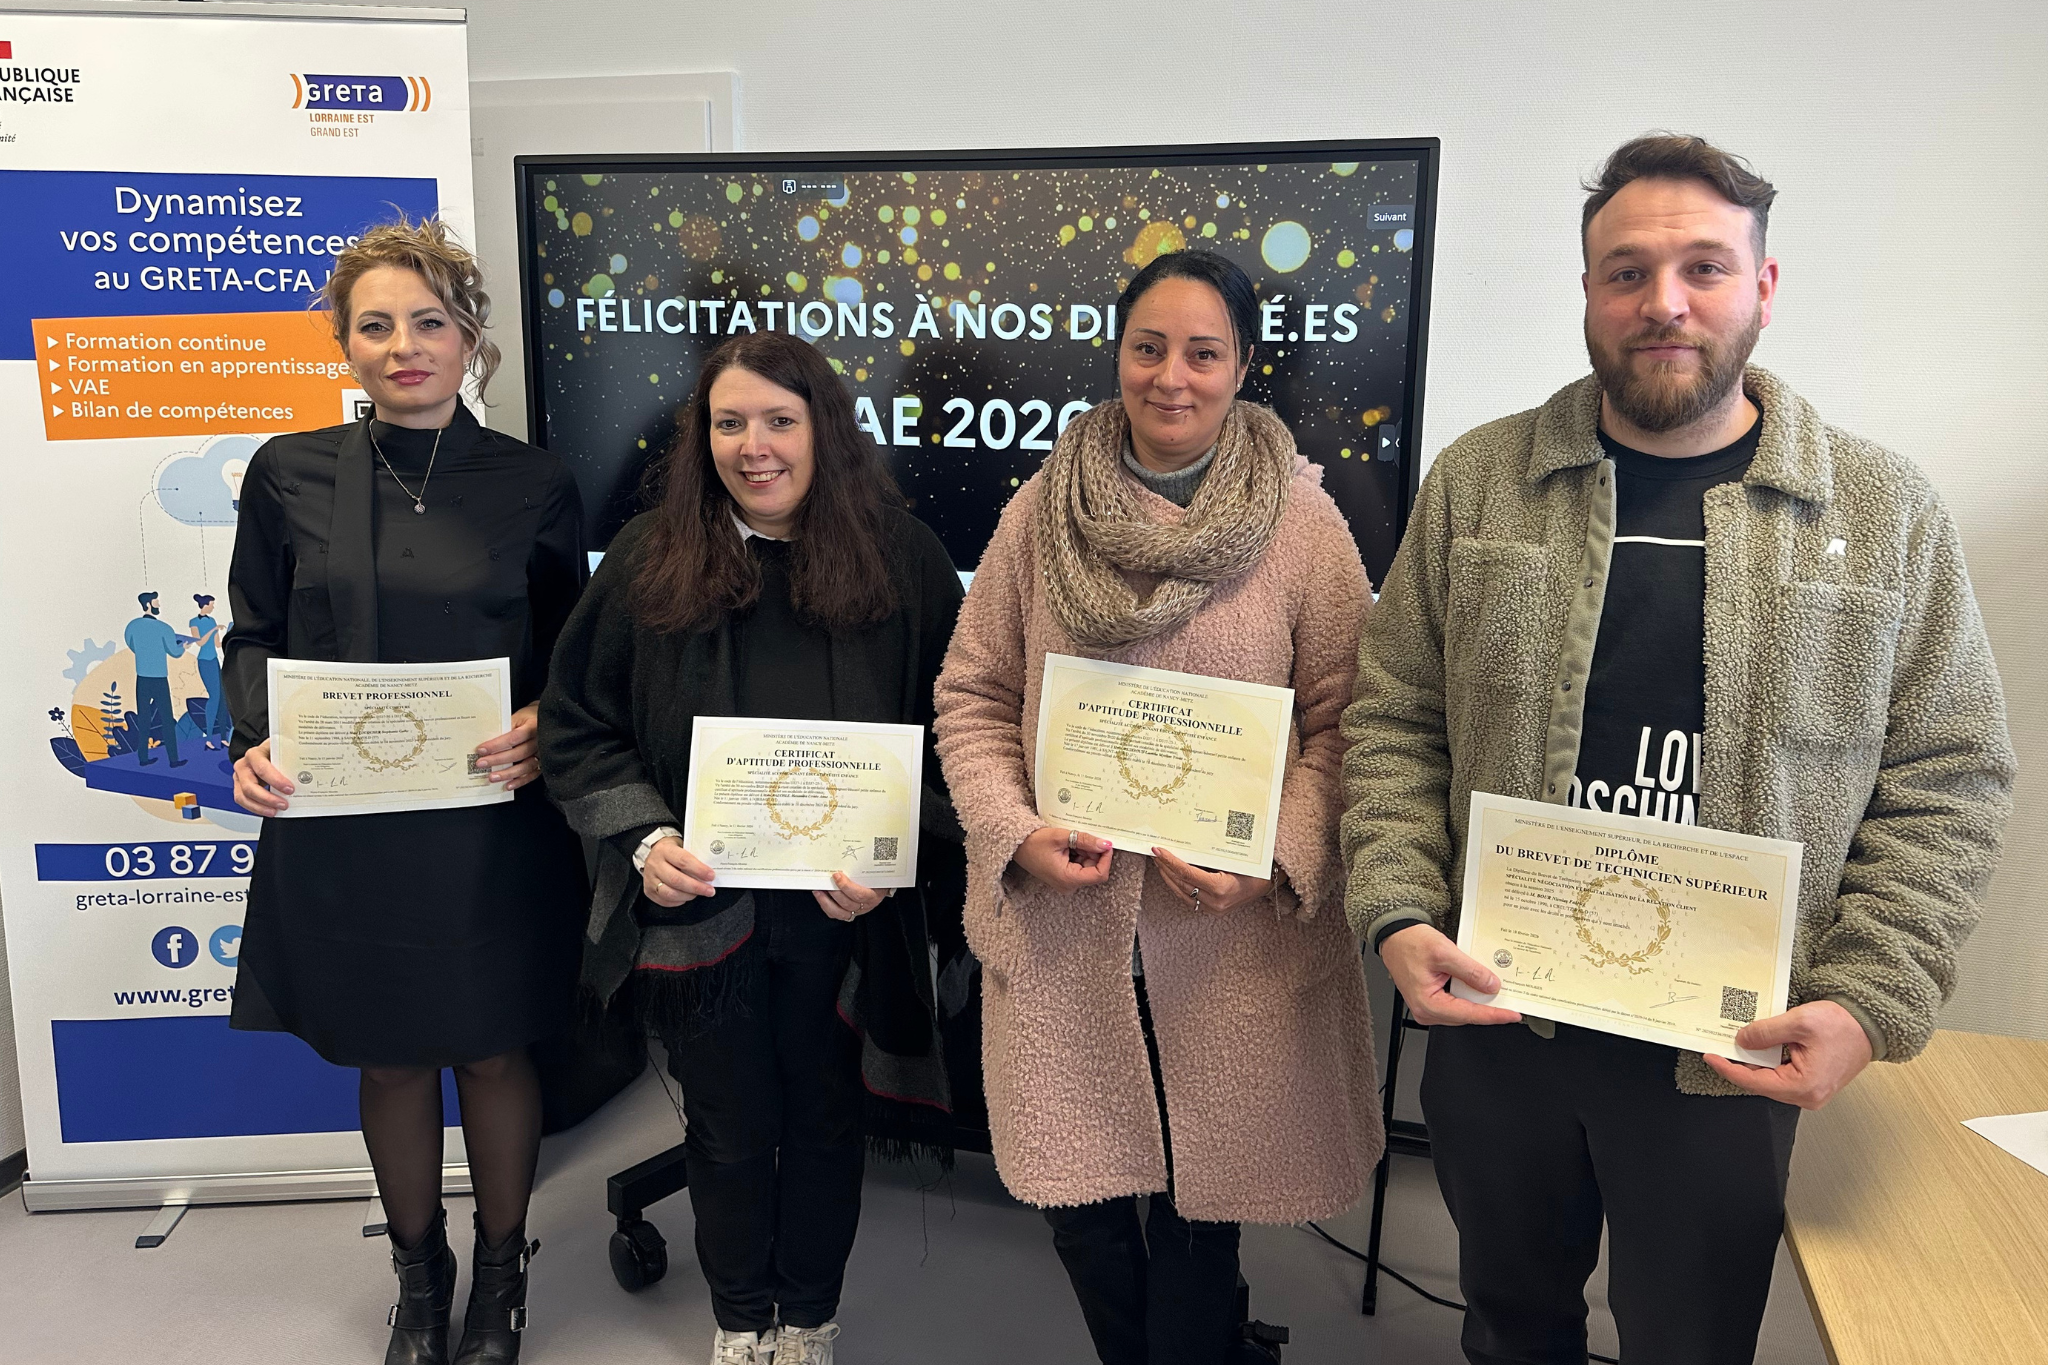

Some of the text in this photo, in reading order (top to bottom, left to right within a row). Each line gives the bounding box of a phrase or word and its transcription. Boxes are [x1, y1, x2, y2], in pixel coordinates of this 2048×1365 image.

[0, 67, 81, 86] UBLIQUE
[0, 87, 74, 105] NÇAISE
[309, 112, 375, 124] LORRAINE EST
[310, 127, 360, 138] GRAND EST
[115, 186, 303, 223] Dynamisez
[1373, 212, 1407, 222] Suivant
[60, 225, 360, 262] vos compétences
[94, 270, 130, 290] au
[140, 266, 316, 293] GRETA-CFA
[576, 290, 895, 338] FÉLICITATIONS
[907, 293, 941, 339] À
[955, 302, 1054, 341] NOS
[66, 333, 267, 352] Formation continue
[67, 355, 350, 380] Formation en apprentissage
[69, 379, 110, 396] VAE
[72, 401, 294, 423] Bilan de compétences
[853, 396, 921, 446] AE
[322, 690, 453, 700] BREVET PROFESSIONNEL
[1128, 699, 1194, 718] CERTIFICAT
[1078, 702, 1243, 737] D'APTITUDE PROFESSIONNELLE
[726, 757, 882, 771] D'APTITUDE PROFESSIONNELLE
[774, 749, 836, 759] CERTIFICAT
[1514, 818, 1546, 828] MINISTÈRE
[1555, 825, 1606, 838] L'ENSEIGNEMENT
[1662, 842, 1699, 853] RECHERCHE
[1719, 852, 1749, 862] L'ESPACE
[105, 843, 255, 878] 03 87 9
[1594, 845, 1660, 866] DIPLÔME
[1495, 844, 1514, 856] DU
[1517, 848, 1572, 866] BREVET
[1574, 858, 1592, 870] DE
[1595, 861, 1683, 885] TECHNICIEN
[1685, 877, 1769, 901] SUPÉRIEUR
[1505, 873, 1536, 883] SPÉCIALITÉ
[1537, 879, 1575, 890] NÉGOCIATION
[1676, 904, 1697, 912] CLIENT
